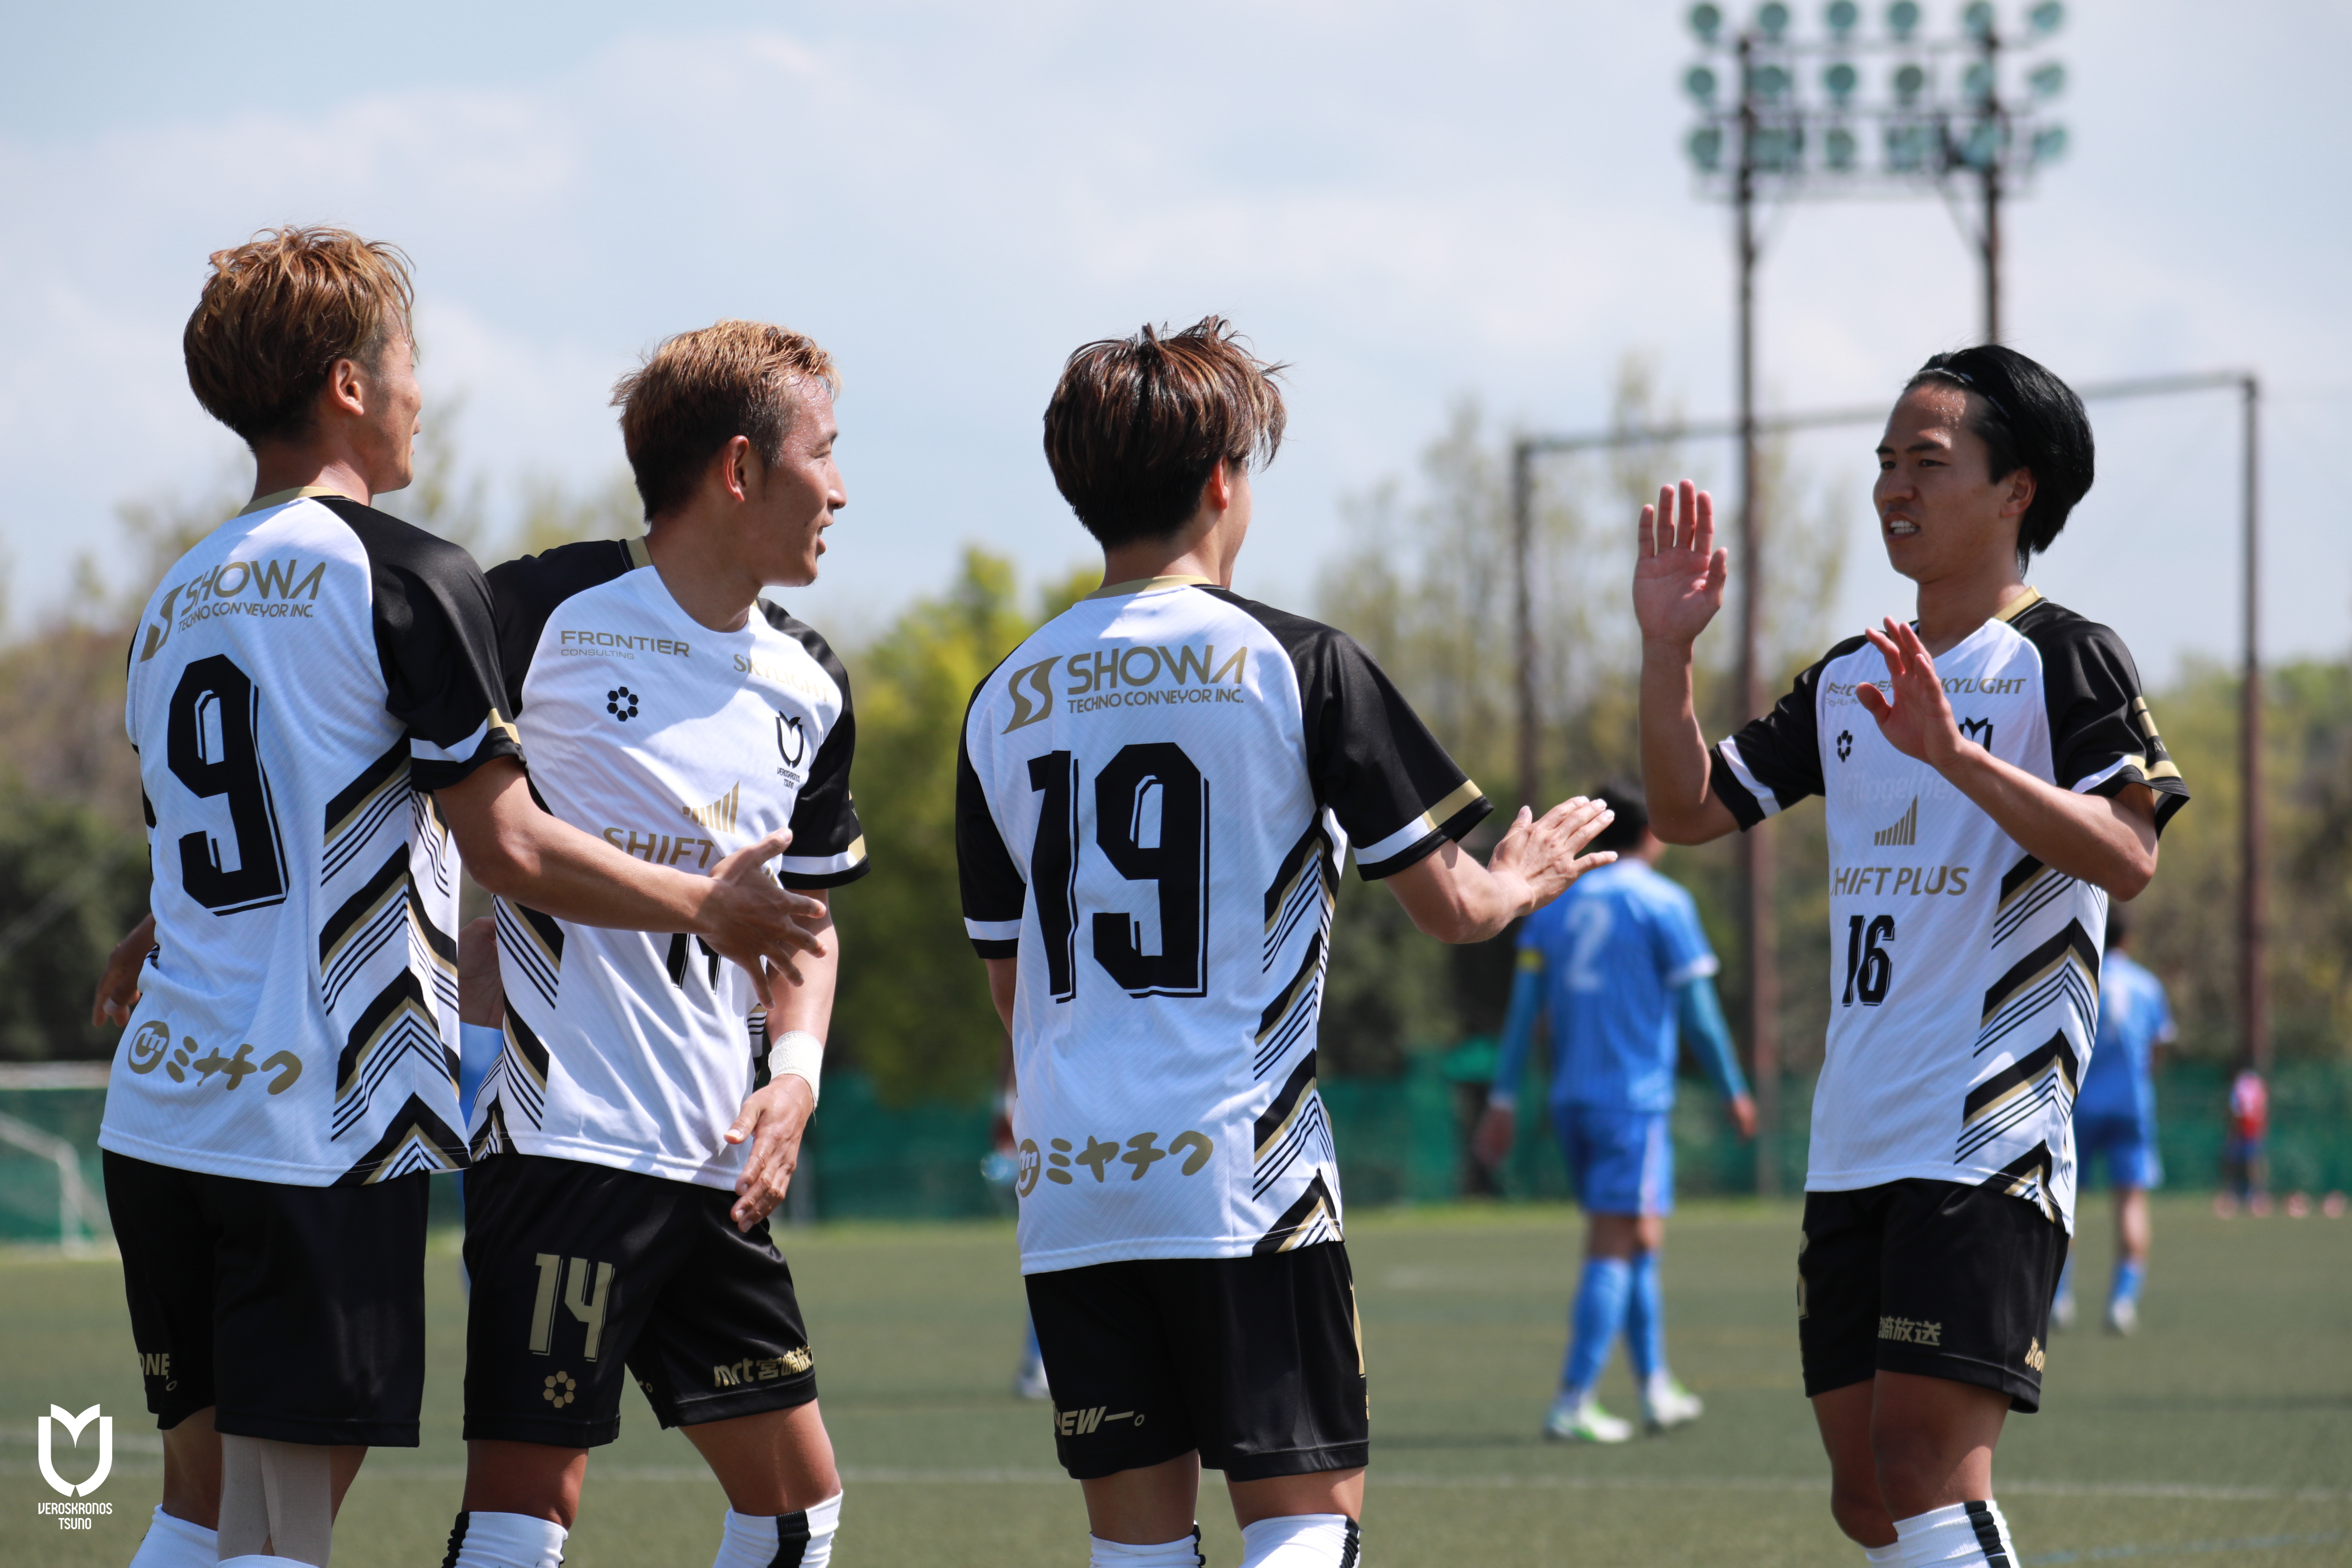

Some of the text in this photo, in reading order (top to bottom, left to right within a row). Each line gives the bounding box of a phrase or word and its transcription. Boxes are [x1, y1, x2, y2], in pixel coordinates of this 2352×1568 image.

[181, 559, 326, 616] SHOWA
[178, 602, 313, 633] TECHNO CONVEYOR INC.
[561, 630, 690, 658] FRONTIER
[561, 649, 635, 660] CONSULTING
[733, 653, 829, 703] SKYLIGHT
[1067, 645, 1248, 695] SHOWA
[1941, 677, 2027, 694] KYLIGHT
[1067, 688, 1244, 714] TECHNO CONVEYOR INC.
[168, 653, 290, 917] 9
[777, 767, 800, 783] VEROSKRONOS
[783, 778, 795, 790] TSUNO
[603, 827, 716, 869] SHIFT
[1027, 741, 1210, 1004] 19
[1830, 866, 1970, 896] HIFT PLUS
[1564, 896, 1614, 993] 2
[1841, 915, 1895, 1007] 16
[528, 1252, 615, 1363] 14
